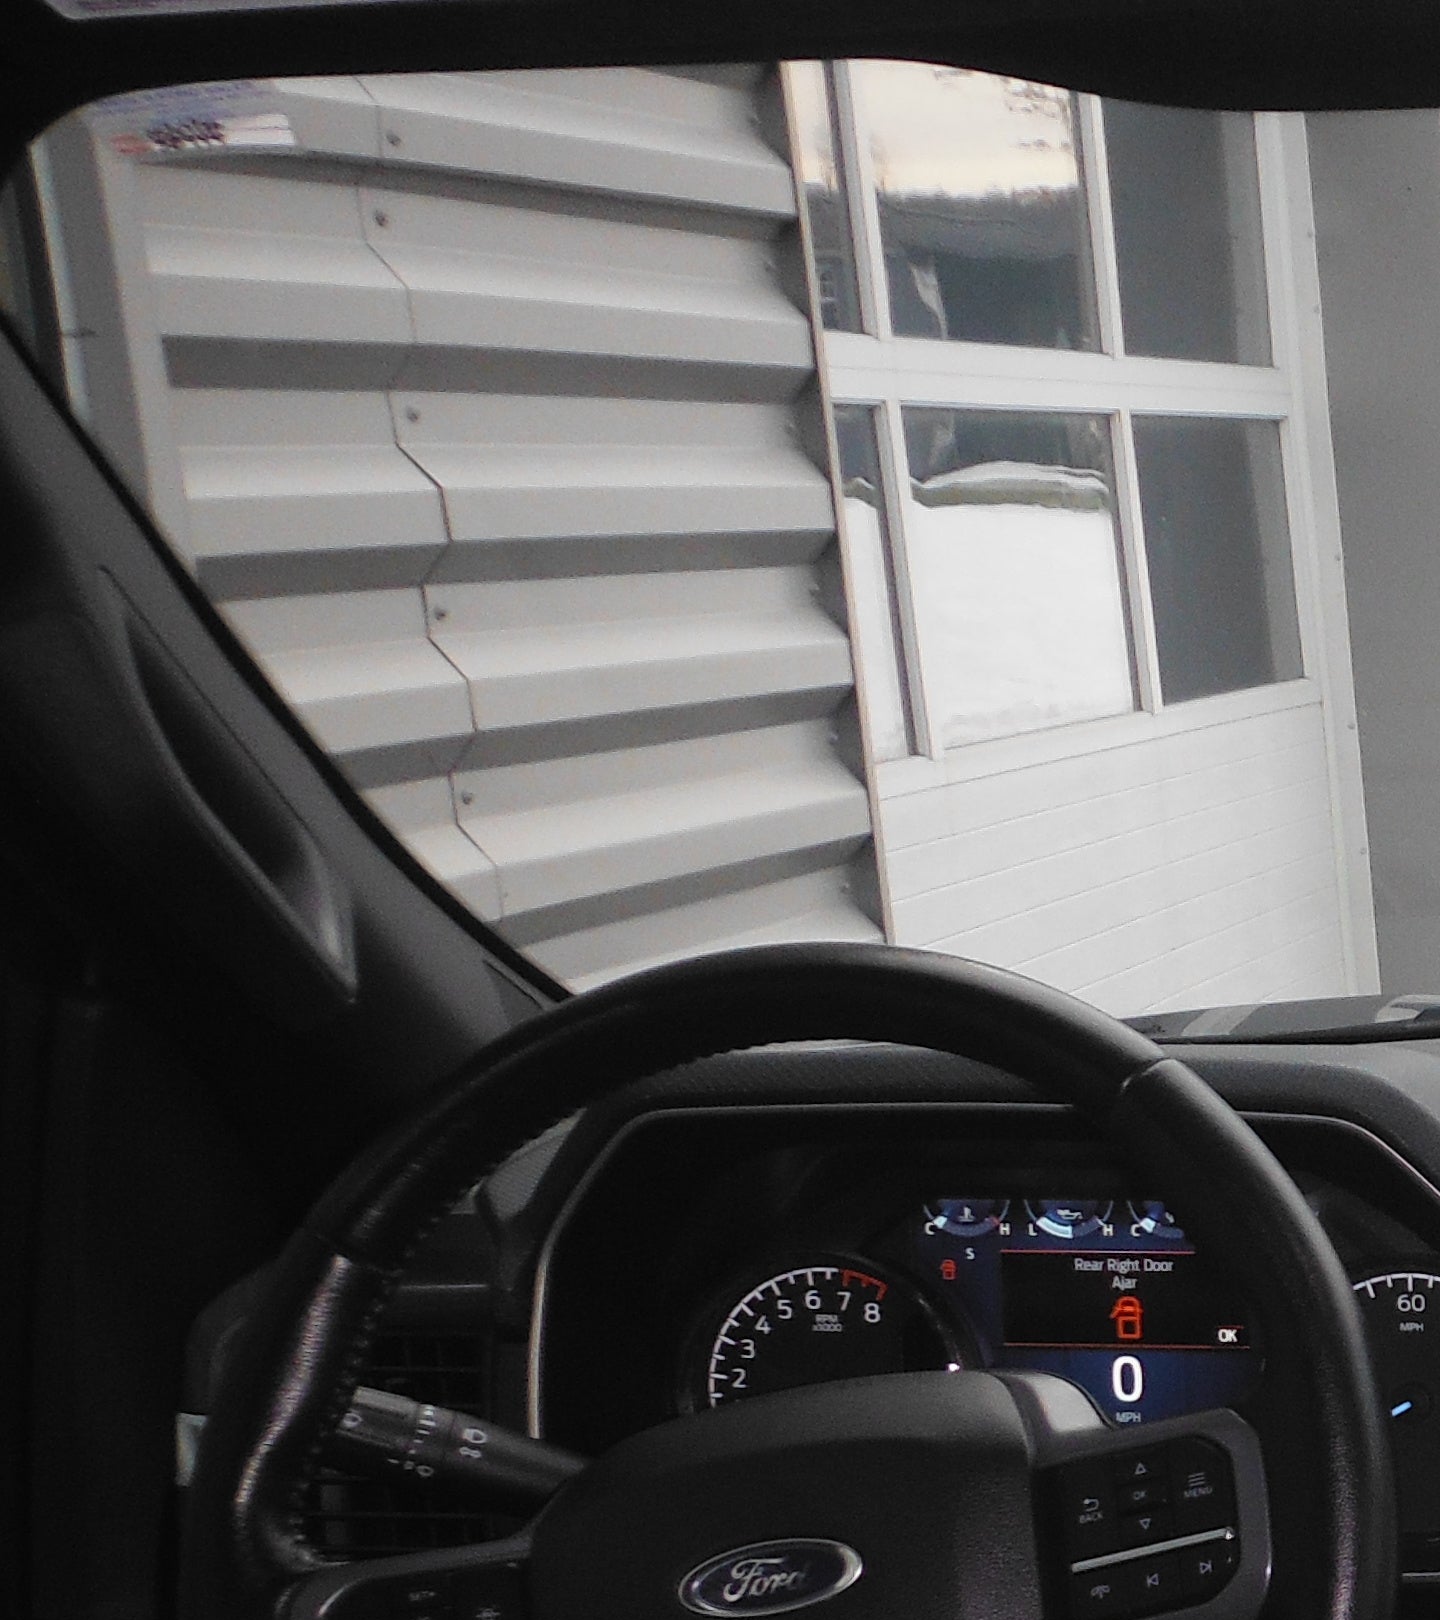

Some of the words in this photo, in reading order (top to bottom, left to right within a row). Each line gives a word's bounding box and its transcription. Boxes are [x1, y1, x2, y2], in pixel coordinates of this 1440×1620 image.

[924, 1221, 936, 1236] C
[999, 1222, 1011, 1236] H
[1027, 1222, 1038, 1237] L
[1102, 1222, 1114, 1237] H
[1129, 1222, 1141, 1237] C
[1074, 1257, 1103, 1272] Rear
[1106, 1257, 1141, 1274] Right
[1143, 1258, 1174, 1273] Door
[1111, 1274, 1138, 1291] Ajar
[804, 1289, 822, 1310] 6
[836, 1290, 851, 1312] 7
[1396, 1293, 1427, 1313] 60
[776, 1299, 793, 1320] 5
[863, 1302, 881, 1323] 8
[754, 1314, 772, 1335] 4
[1399, 1322, 1425, 1333] MPH
[1217, 1328, 1238, 1343] OK
[740, 1338, 756, 1360] 3
[731, 1367, 748, 1389] 2
[1111, 1355, 1144, 1403] 0
